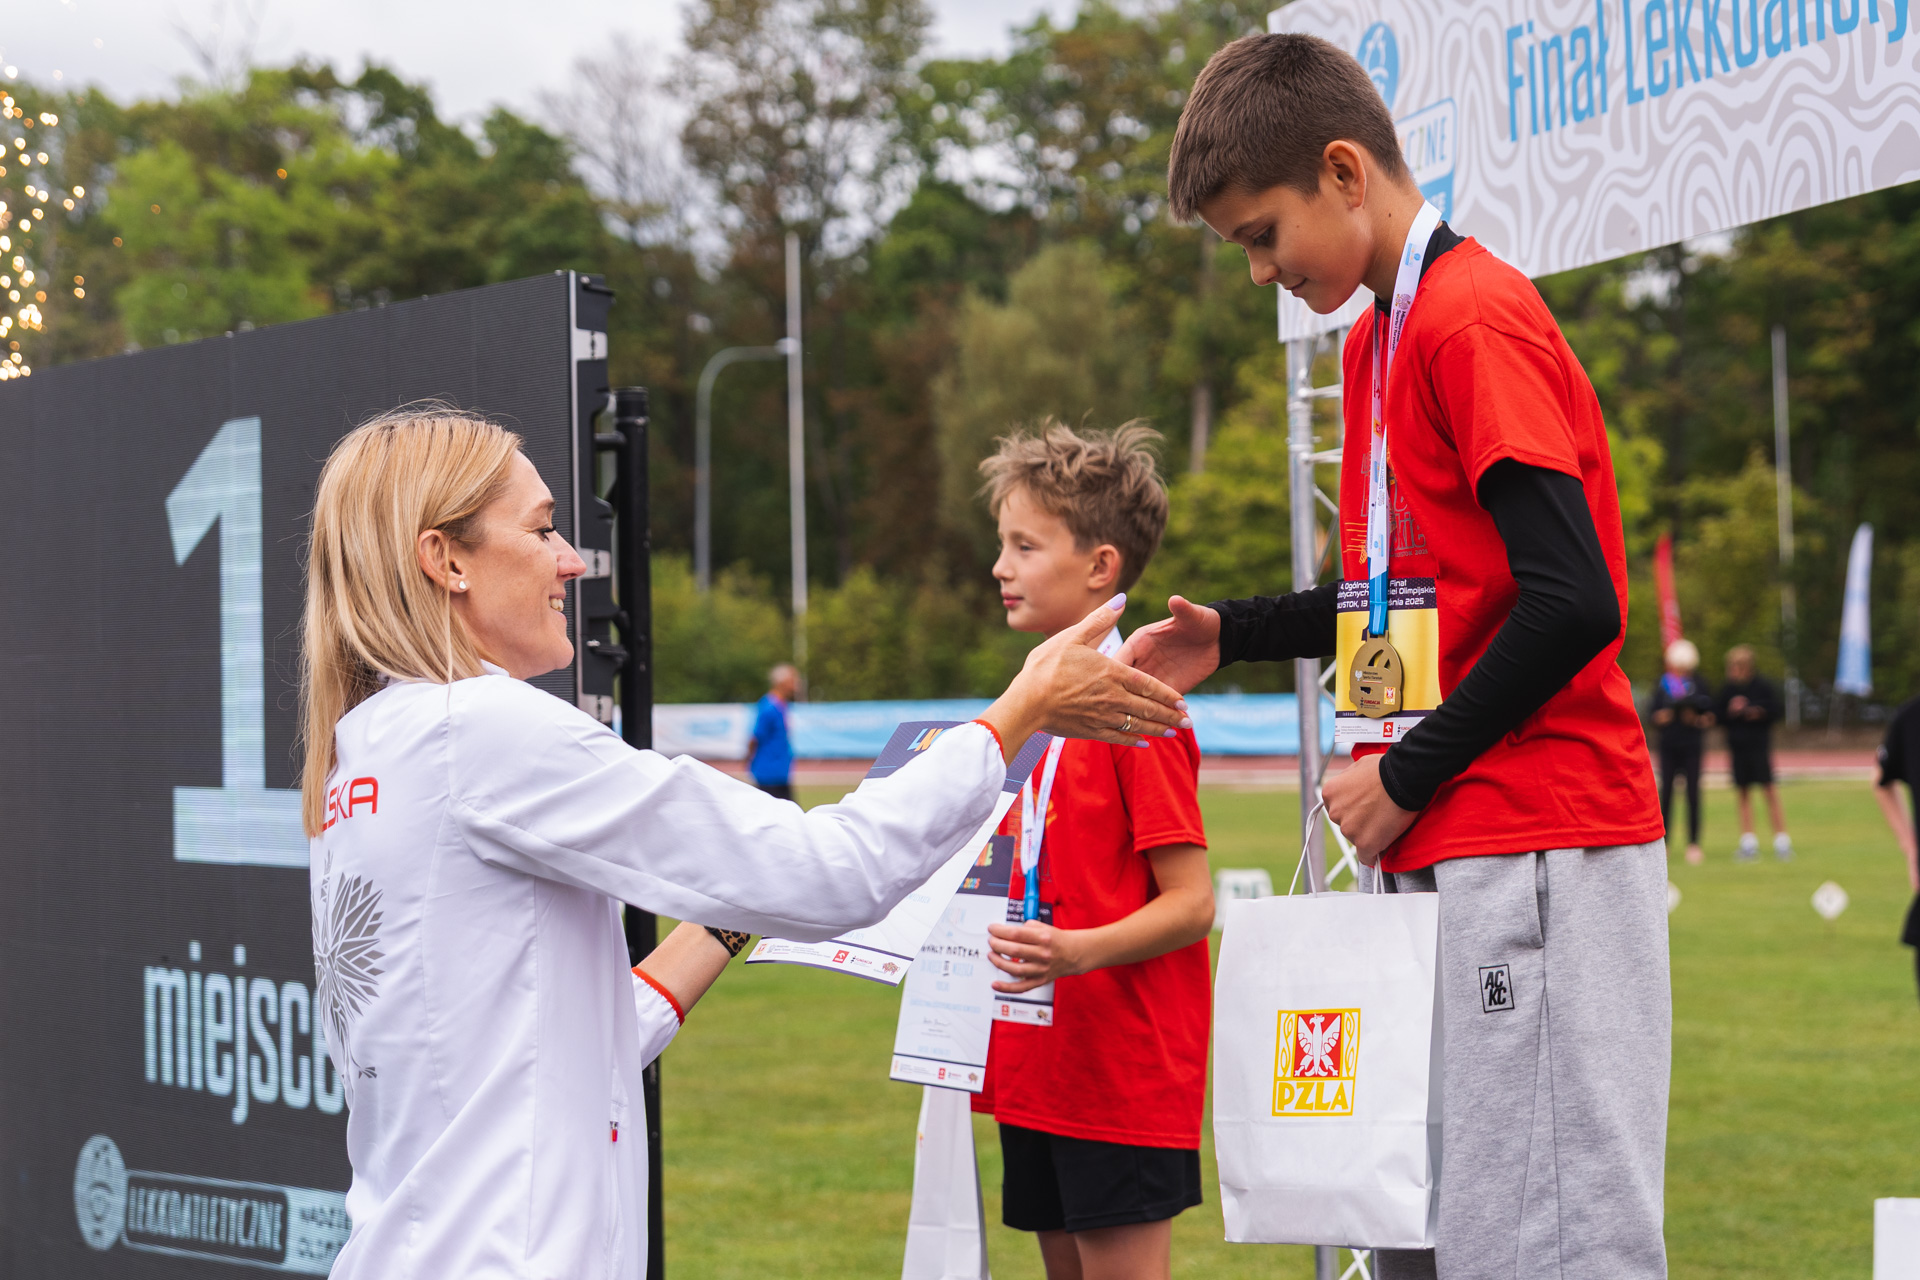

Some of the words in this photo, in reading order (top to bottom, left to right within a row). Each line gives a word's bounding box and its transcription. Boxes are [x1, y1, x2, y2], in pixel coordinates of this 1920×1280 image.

[1506, 0, 1608, 141] Finał
[1389, 579, 1407, 587] Finał
[1405, 597, 1424, 606] 2025
[166, 416, 312, 868] 1
[144, 940, 345, 1125] miejsce
[1276, 1081, 1349, 1112] PZLA
